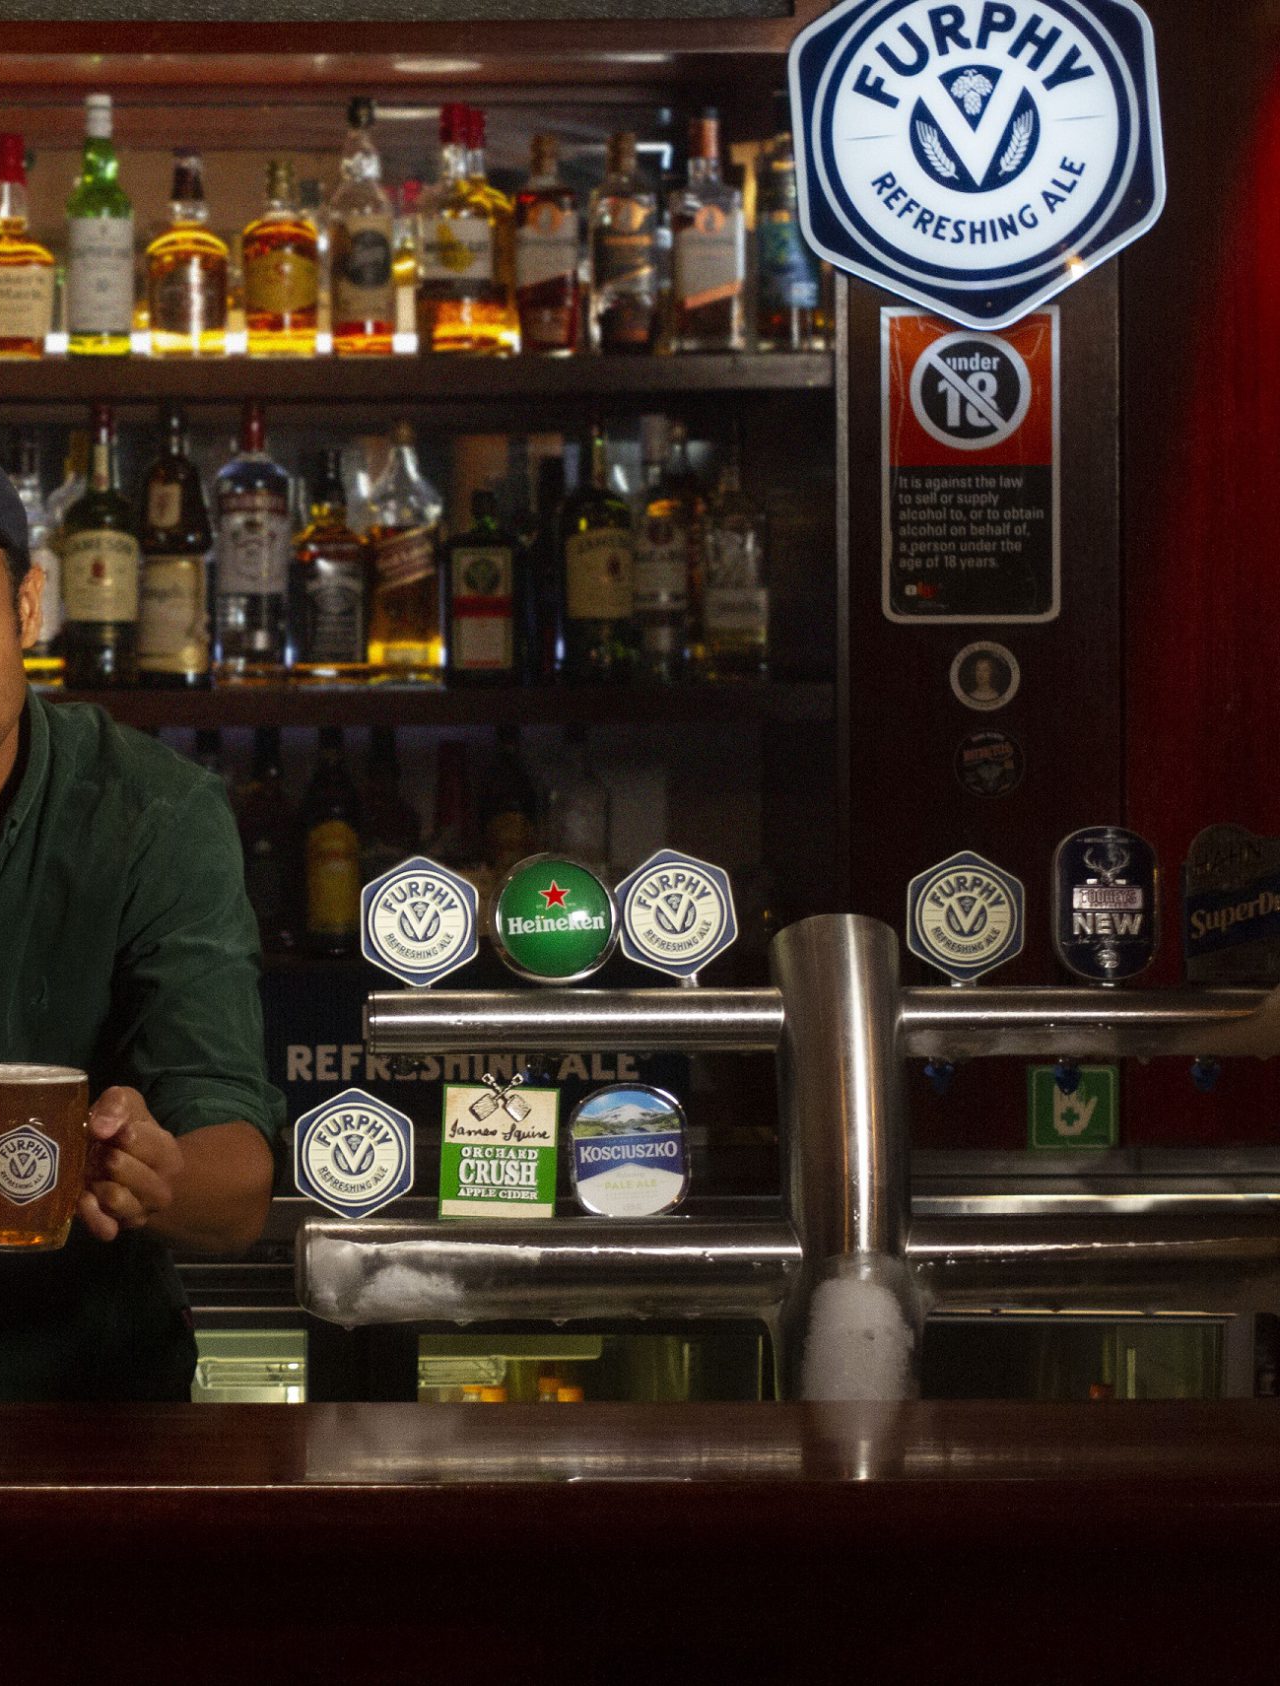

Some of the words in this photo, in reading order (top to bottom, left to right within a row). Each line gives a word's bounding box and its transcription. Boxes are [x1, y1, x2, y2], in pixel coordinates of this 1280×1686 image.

[852, 1, 1095, 110] FURPHY
[870, 170, 1040, 246] REFRESHING
[1043, 155, 1087, 215] ALE
[946, 356, 1000, 371] under
[937, 371, 999, 428] 18
[899, 476, 908, 489] It
[911, 476, 922, 489] is
[925, 476, 971, 492] against
[975, 476, 996, 489] the
[1000, 476, 1023, 489] law
[898, 493, 912, 504] to
[915, 492, 937, 504] sell
[940, 495, 952, 504] or
[956, 492, 999, 507] supply
[899, 508, 947, 521] alcohol
[970, 510, 983, 520] or
[987, 509, 1000, 520] to
[1004, 507, 1044, 520] obtain
[899, 524, 947, 537] alcohol
[950, 526, 966, 536] on
[970, 523, 1010, 536] behalf
[911, 542, 956, 555] person
[960, 540, 997, 552] under
[1000, 540, 1022, 552] the
[899, 557, 921, 570] age
[926, 555, 939, 568] of
[944, 555, 957, 568] 18
[381, 880, 459, 915] FURPHY
[635, 872, 712, 910] FURPHY
[928, 875, 1006, 908] FURPHY
[507, 912, 606, 935] Heineken
[644, 929, 699, 952] REFRESHING
[699, 919, 712, 939] ALE
[1072, 912, 1143, 935] NEW
[384, 932, 439, 960] REFRESHING
[438, 932, 455, 952] ALE
[932, 926, 985, 954] REFRESHING
[984, 927, 1001, 946] ALE
[287, 1044, 530, 1081] REFRSHIN
[557, 1052, 640, 1080] ALE
[314, 1113, 393, 1148] FURPHY
[448, 1118, 498, 1138] James
[502, 1123, 551, 1142] Squire
[0, 1140, 48, 1160] FURPHY
[461, 1146, 538, 1159] ORCHARD
[579, 1141, 678, 1163] KOSCIUSZKO
[318, 1166, 373, 1193] REFRESHING
[373, 1166, 388, 1187] ALE
[459, 1158, 538, 1186] CRUSH
[457, 1187, 497, 1198] APPLE
[499, 1190, 538, 1200] CIDER
